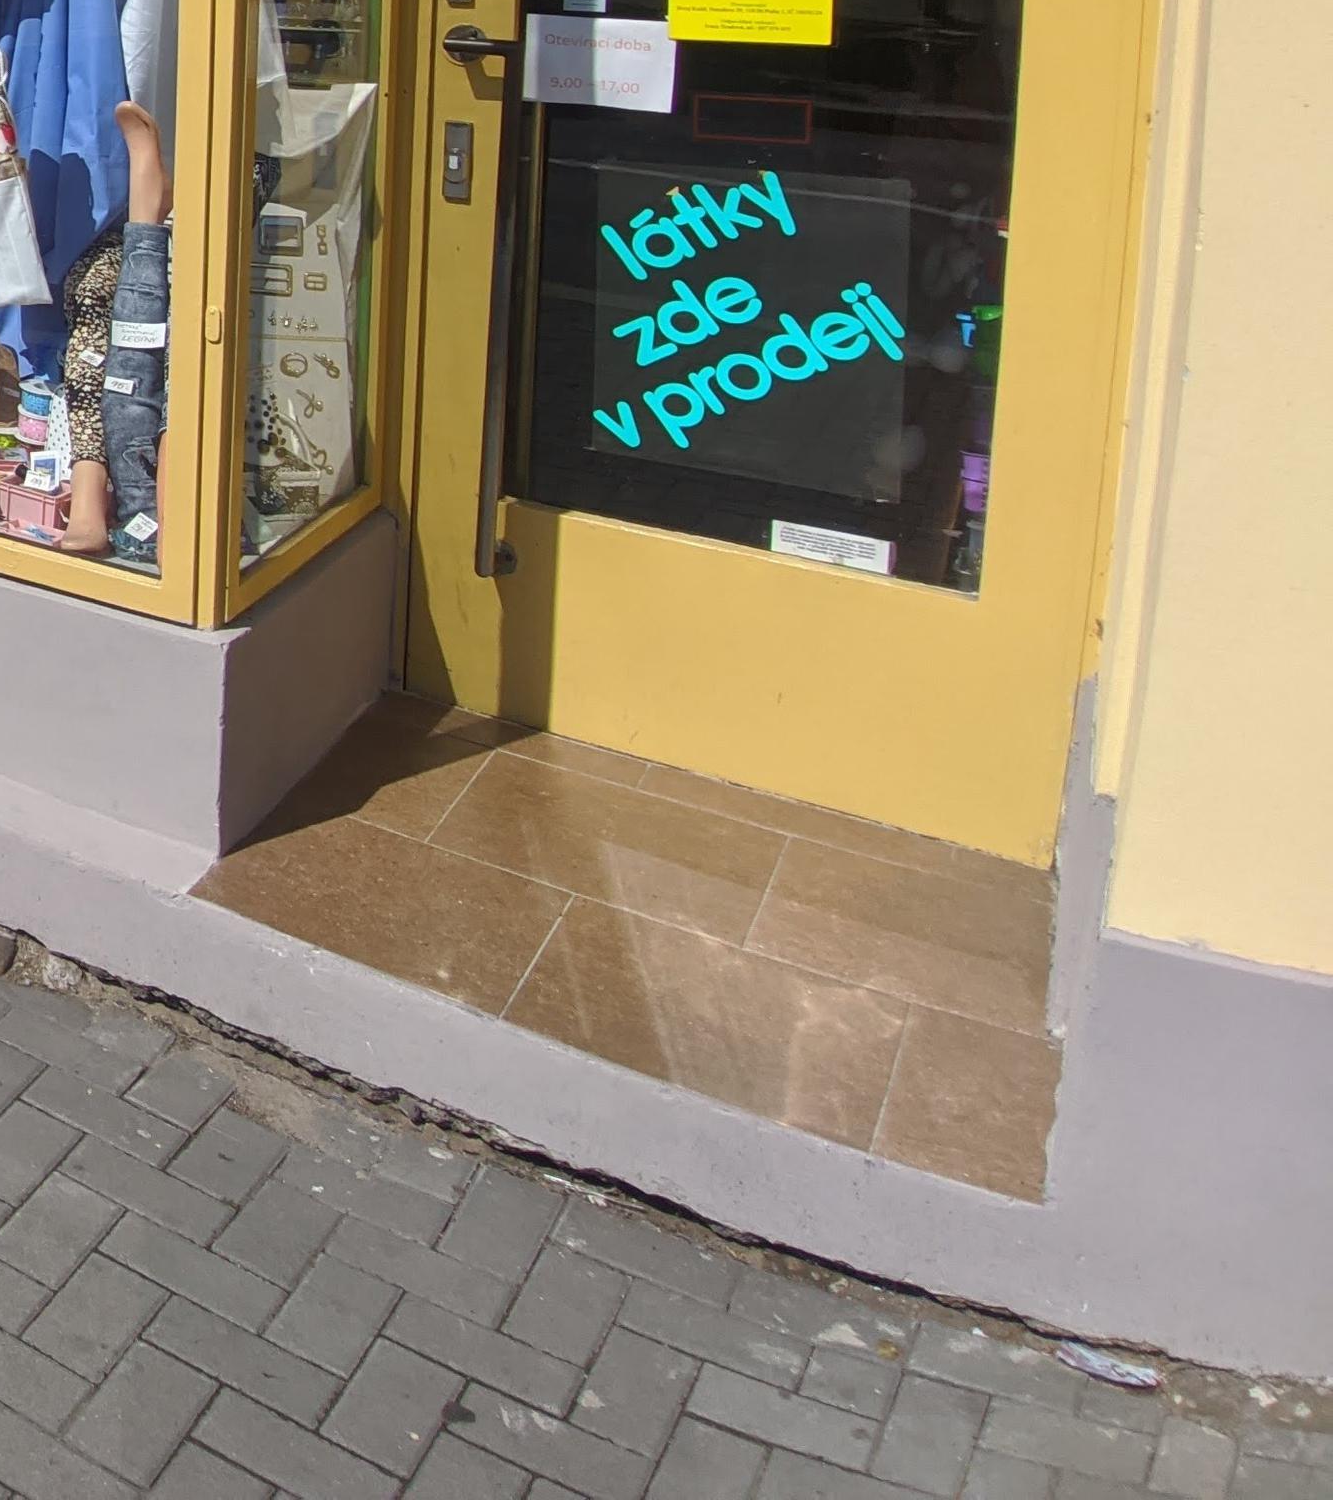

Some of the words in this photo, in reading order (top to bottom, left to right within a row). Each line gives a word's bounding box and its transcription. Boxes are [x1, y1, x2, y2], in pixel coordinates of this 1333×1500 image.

[549, 76, 582, 90] 9.00
[613, 38, 652, 53] doba
[600, 170, 797, 281] látky
[592, 400, 642, 449] v
[642, 281, 906, 449] prodeji
[612, 276, 763, 367] zde
